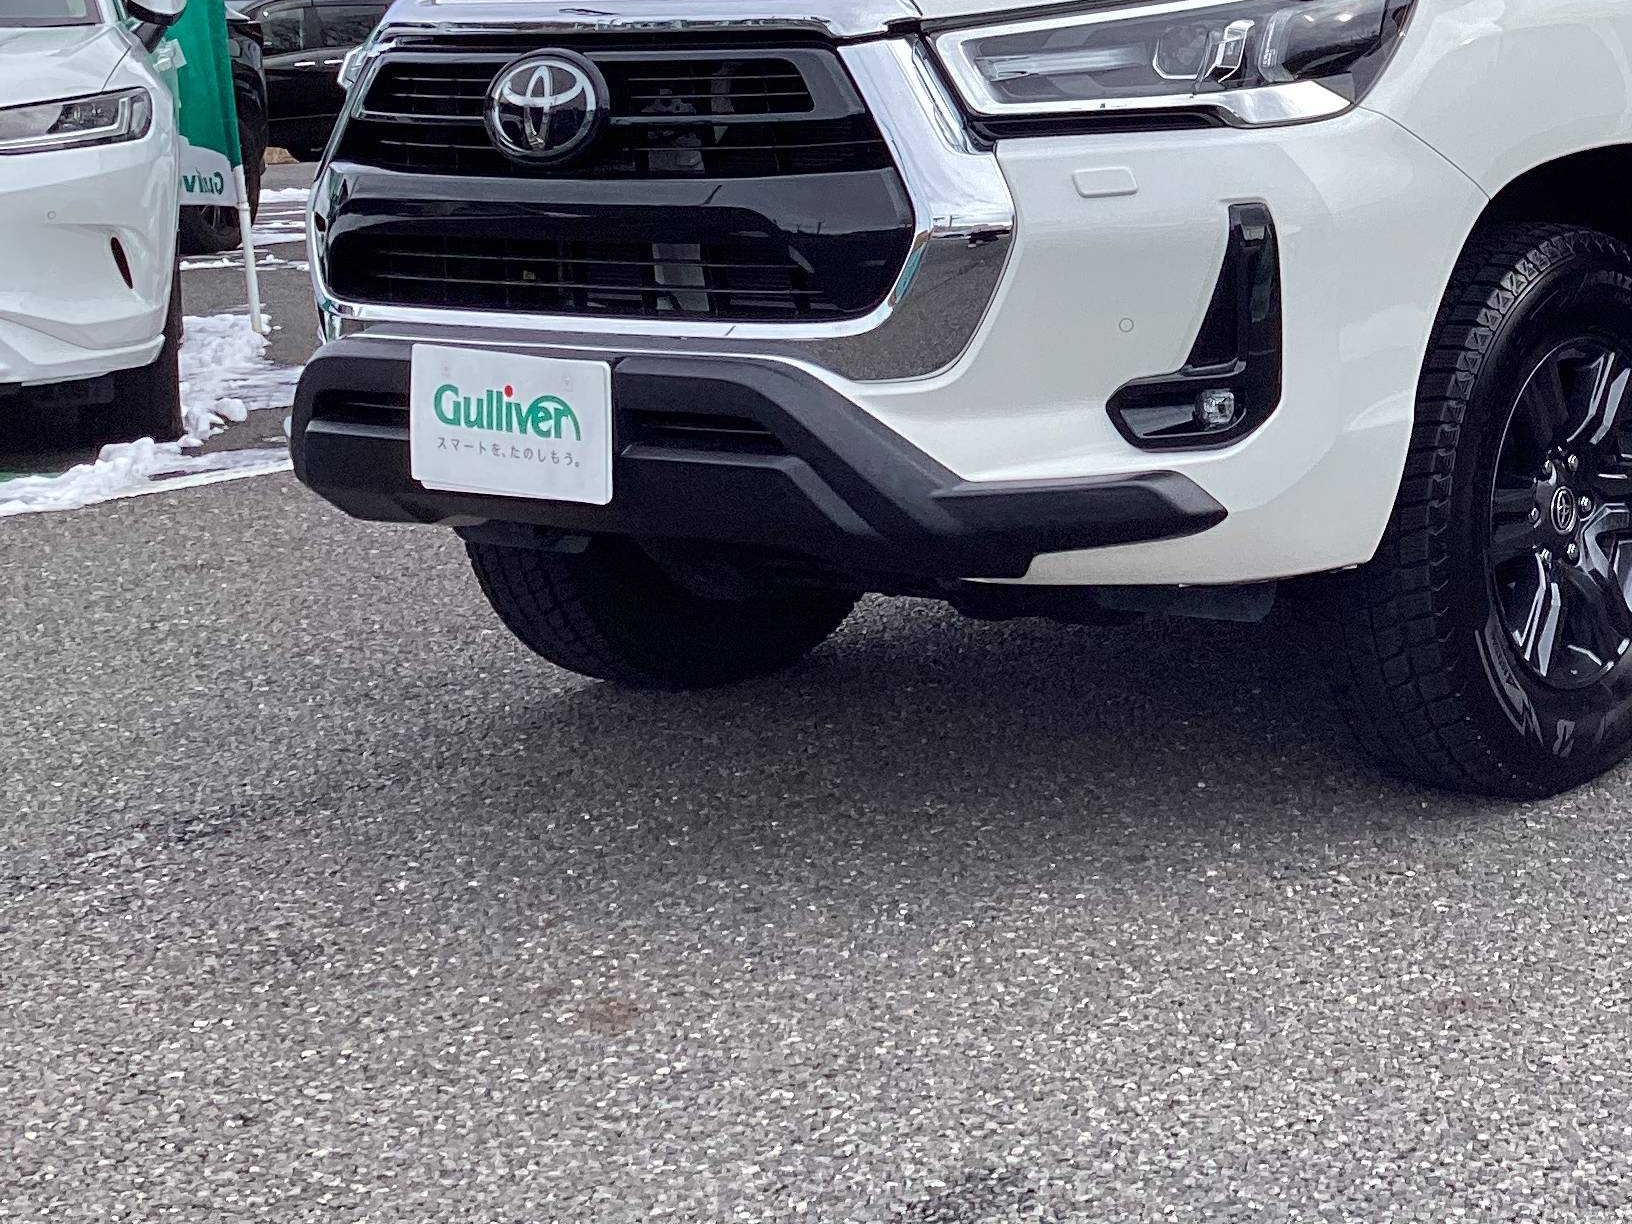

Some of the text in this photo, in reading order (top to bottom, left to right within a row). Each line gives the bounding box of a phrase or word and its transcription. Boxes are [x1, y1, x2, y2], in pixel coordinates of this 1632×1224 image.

[433, 384, 582, 441] Gulliver
[437, 437, 580, 469] スマートを、たのしもう。
